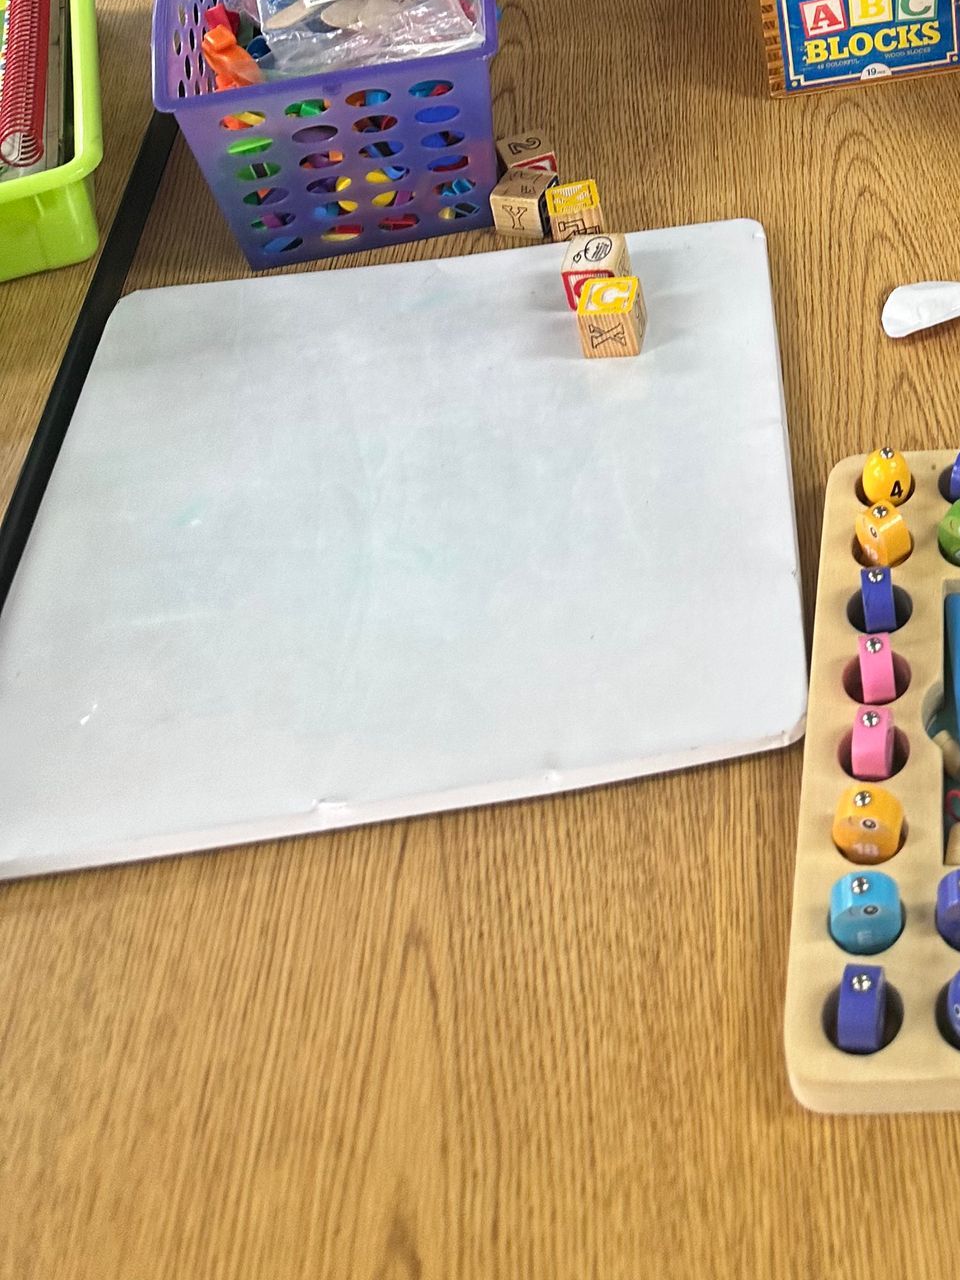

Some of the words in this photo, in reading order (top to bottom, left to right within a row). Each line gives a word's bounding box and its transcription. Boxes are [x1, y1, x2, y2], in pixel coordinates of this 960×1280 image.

[804, 20, 941, 65] BLOCKS
[502, 205, 527, 231] Y
[890, 480, 904, 498] 4
